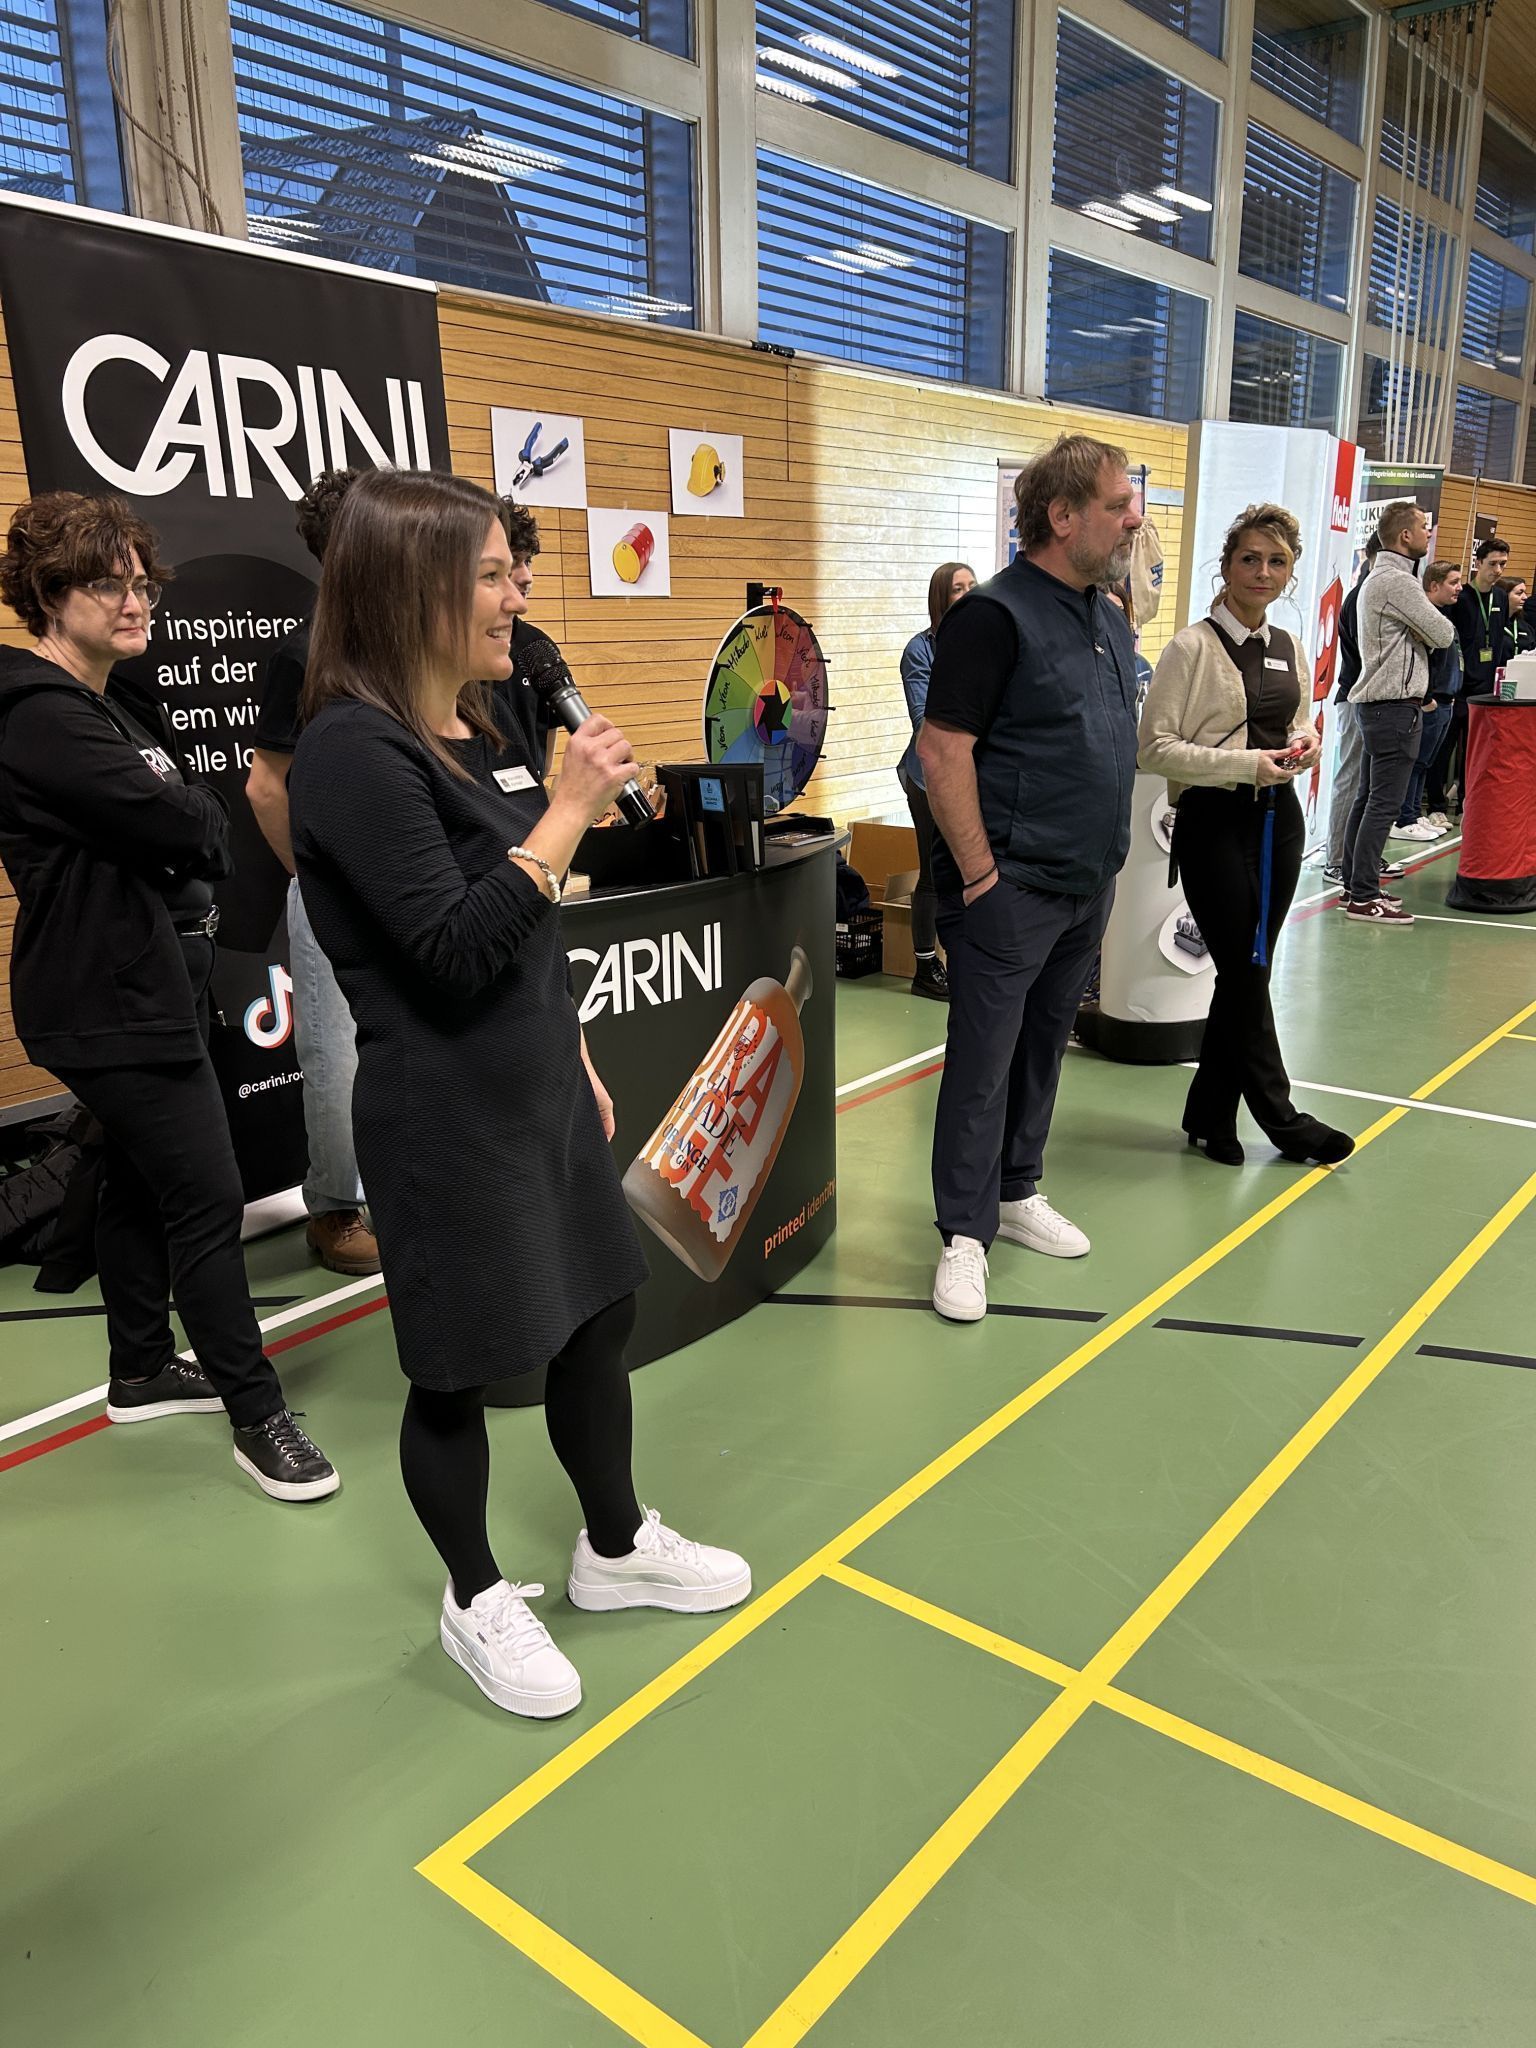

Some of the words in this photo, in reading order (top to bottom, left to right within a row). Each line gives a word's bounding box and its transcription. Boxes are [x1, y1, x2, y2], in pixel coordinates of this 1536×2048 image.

[62, 333, 432, 502] CARINI
[165, 610, 304, 648] inspiriere
[157, 656, 201, 687] auf
[211, 655, 258, 684] der
[706, 1069, 733, 1105] GIN
[662, 1122, 710, 1174] ORANGE
[764, 1206, 805, 1260] printed
[807, 1177, 836, 1220] identity
